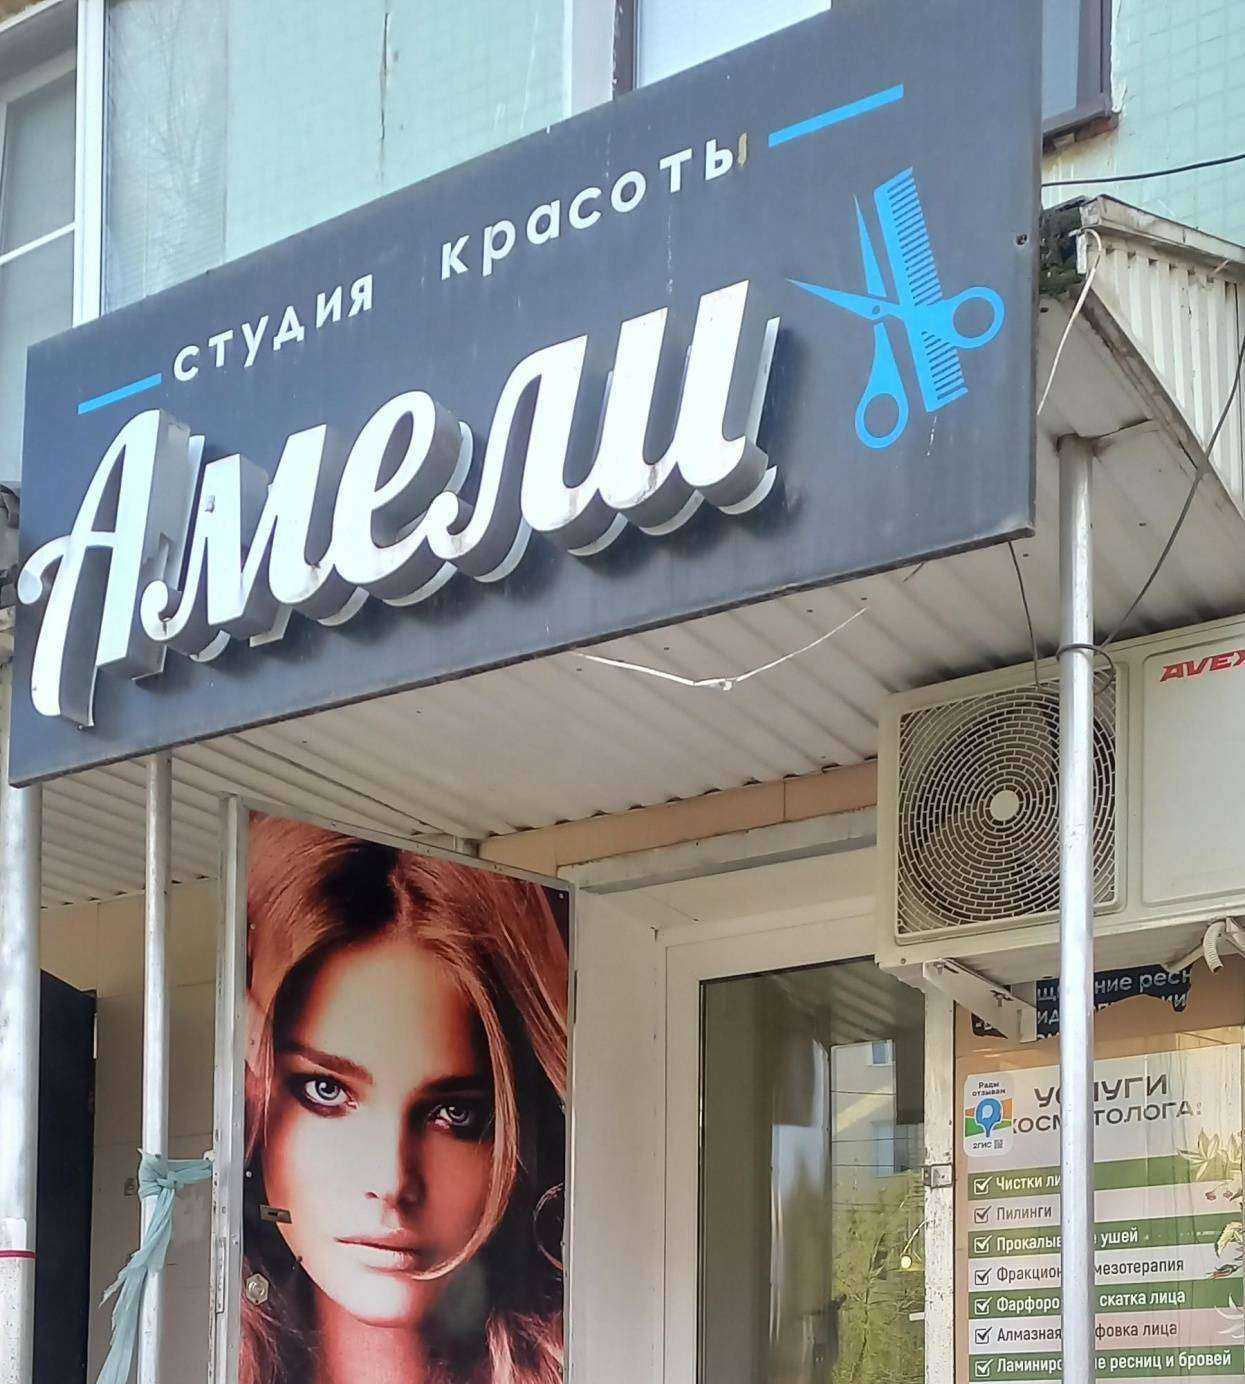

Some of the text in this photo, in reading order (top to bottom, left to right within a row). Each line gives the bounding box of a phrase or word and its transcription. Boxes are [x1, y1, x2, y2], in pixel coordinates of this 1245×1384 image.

[173, 133, 748, 382] студия красоты
[18, 279, 750, 718] Амели
[972, 1088, 1006, 1097] отзывам
[1034, 1074, 1167, 1107] УУГИ
[973, 1141, 992, 1149] 2ГИС
[996, 1174, 1062, 1191] Чистки ли
[996, 1206, 1052, 1221] Пилинги
[996, 1227, 1138, 1253] Прокалыв ушей
[996, 1266, 1062, 1282] Фракцион
[996, 1290, 1186, 1315] Фарфоро скатка лица
[997, 1322, 1177, 1342] Алмазная фовка лица
[997, 1350, 1231, 1374] Ламинирое ресниц и бровей
